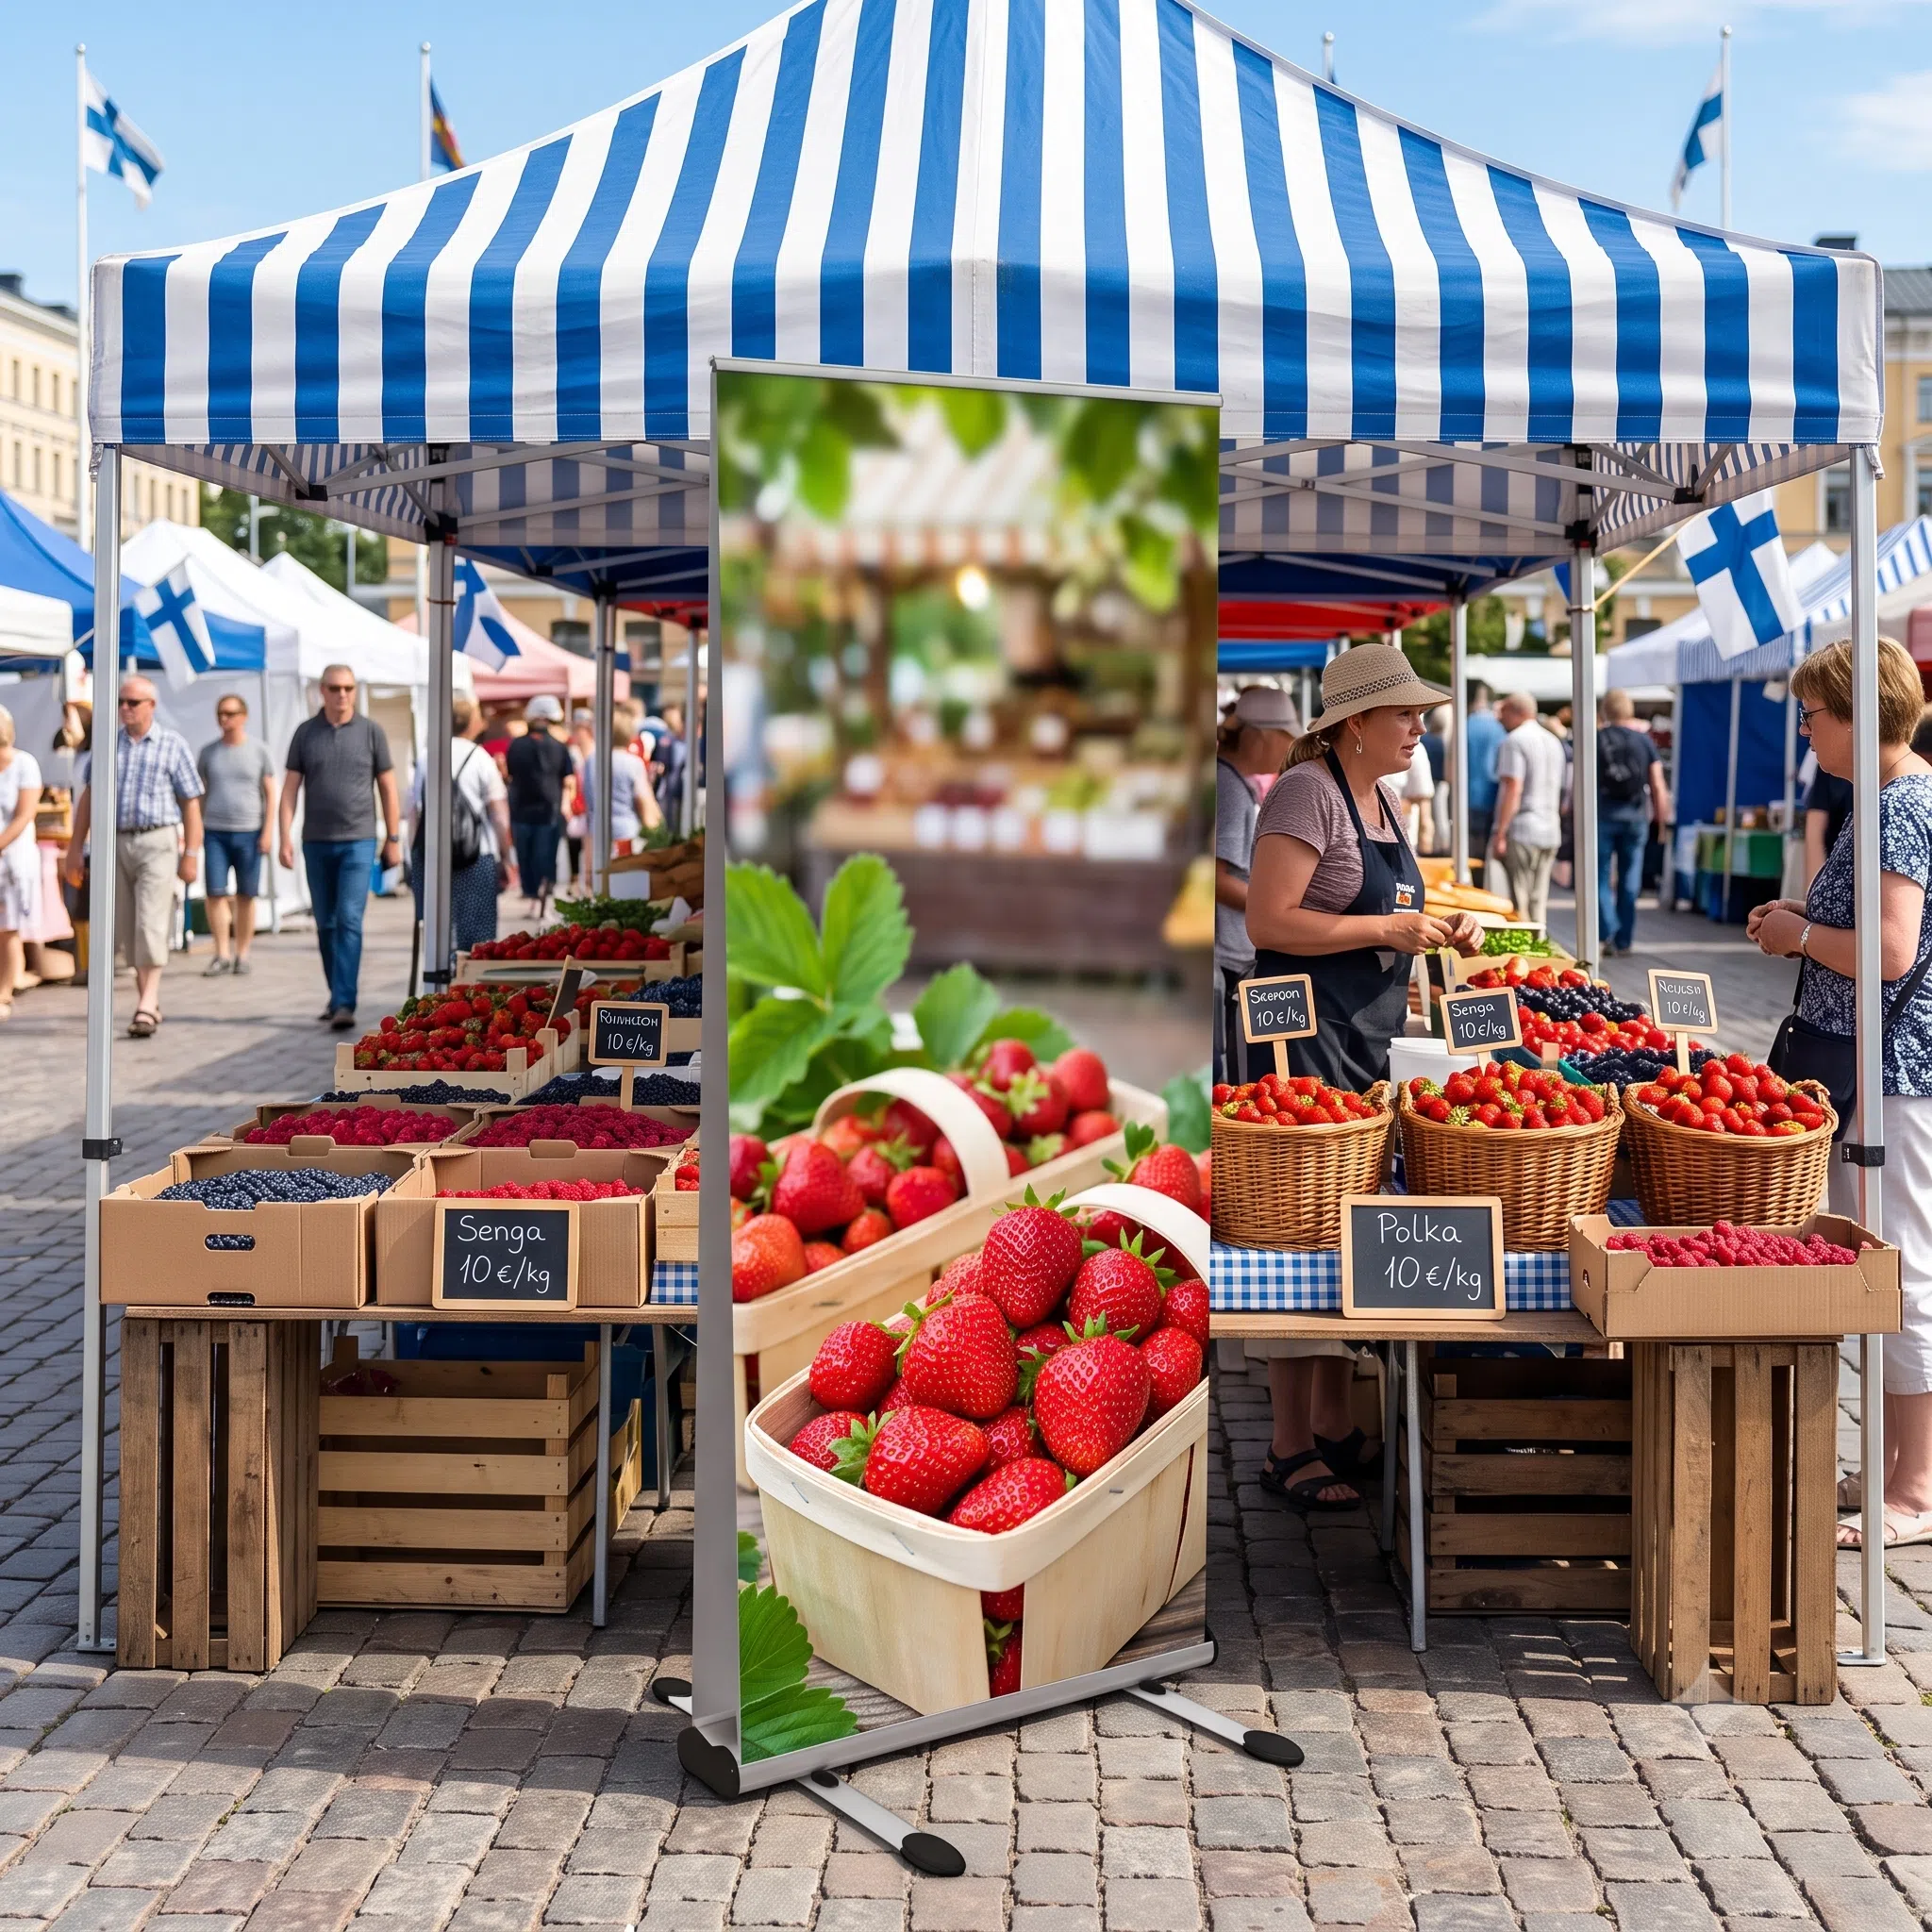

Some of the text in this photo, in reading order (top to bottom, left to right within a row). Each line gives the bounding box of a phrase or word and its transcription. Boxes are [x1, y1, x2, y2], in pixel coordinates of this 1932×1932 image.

[1256, 1006, 1306, 1027] 10 €/kg
[1451, 1003, 1495, 1017] Senga
[1667, 1001, 1681, 1014] 10
[1458, 1019, 1507, 1040] 10 €/kg
[607, 1033, 654, 1057] 10 €/kg
[457, 1215, 546, 1254] Senga
[1377, 1212, 1462, 1244] Polka
[459, 1254, 550, 1294] 10 €/kg
[1384, 1256, 1481, 1301] 10 €/kg
